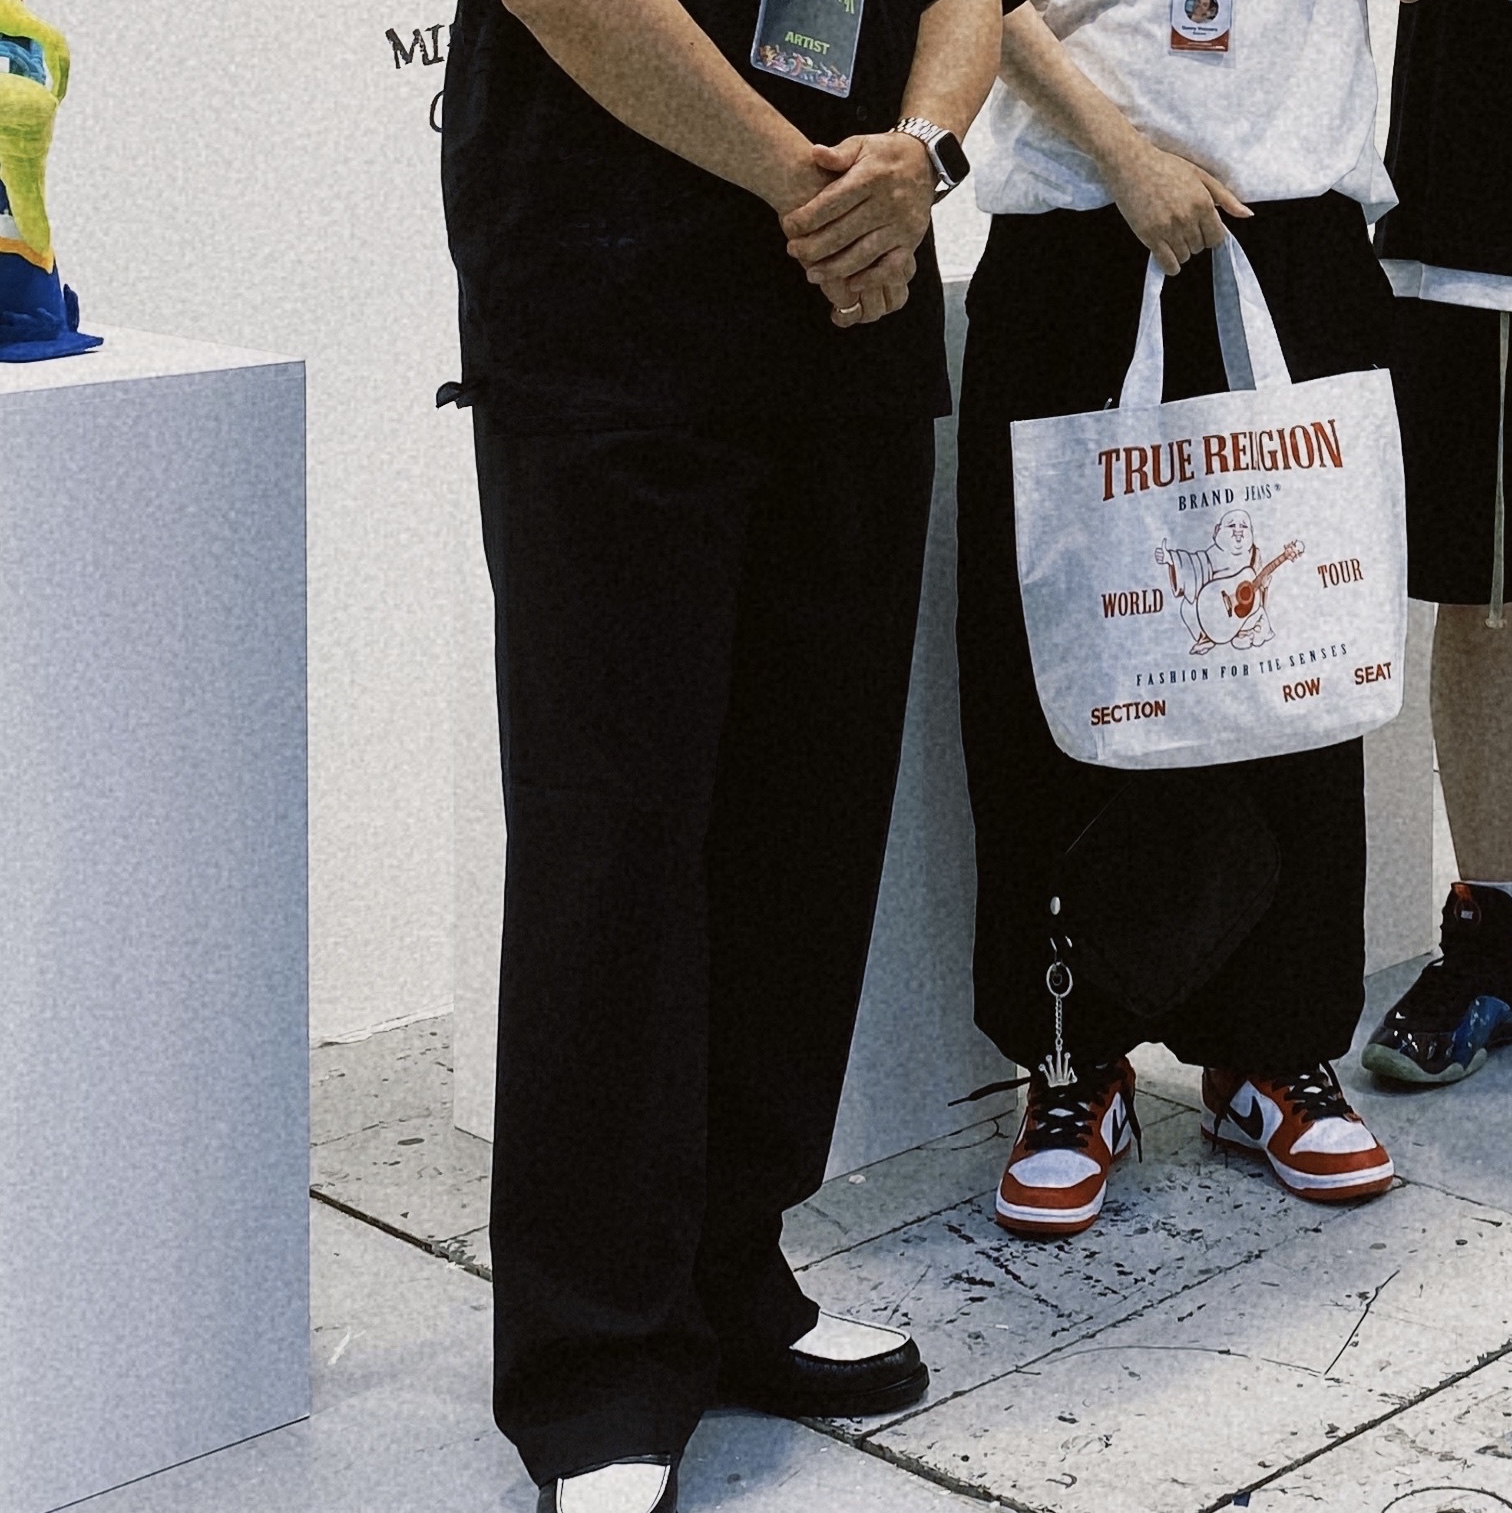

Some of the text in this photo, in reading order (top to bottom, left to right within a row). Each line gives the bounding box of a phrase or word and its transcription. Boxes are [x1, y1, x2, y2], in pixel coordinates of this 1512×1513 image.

[784, 31, 830, 55] ARTIST
[1097, 438, 1195, 502] TRUE
[1178, 488, 1234, 511] BRAND
[1101, 558, 1364, 619] WORLD TOUR
[1136, 667, 1209, 687] FASHION
[1220, 664, 1250, 680] FOR
[1289, 643, 1349, 668] SENSES
[1090, 662, 1393, 726] SECTION ROW SEAT
